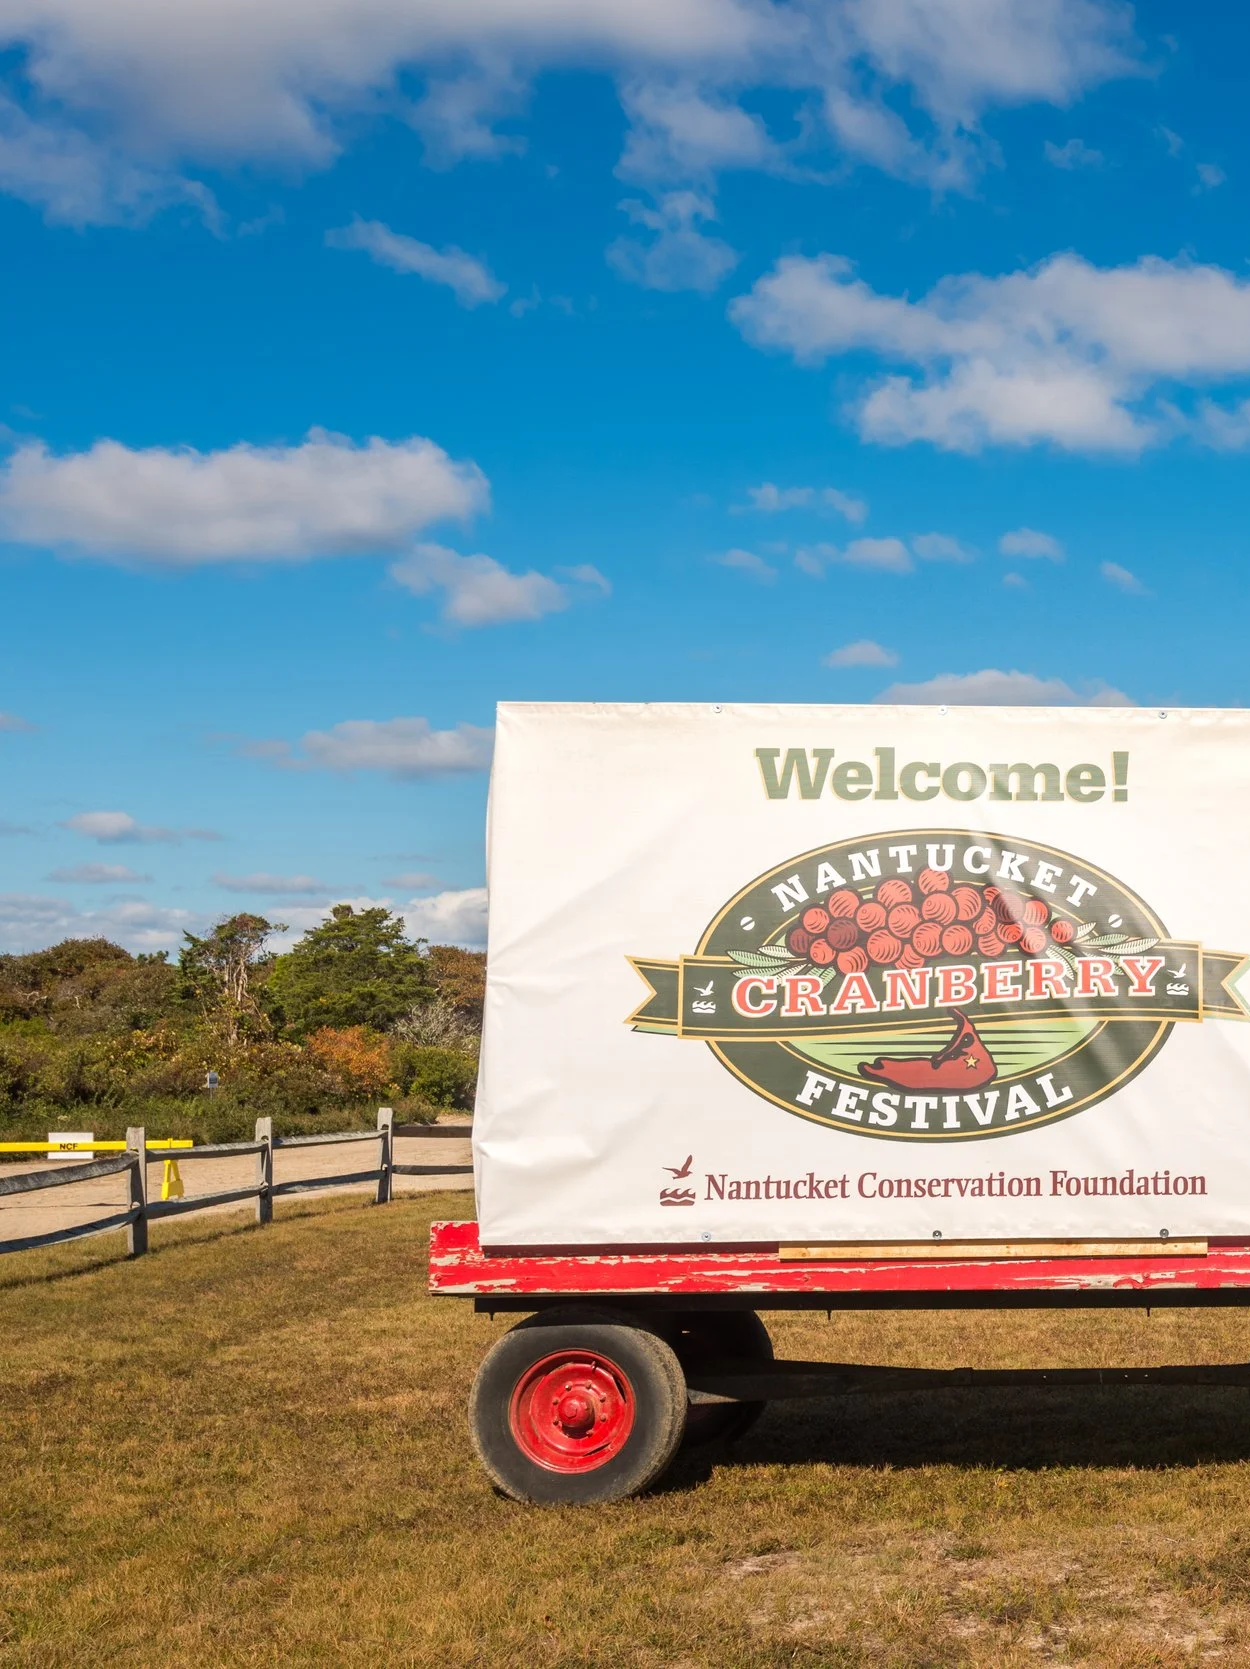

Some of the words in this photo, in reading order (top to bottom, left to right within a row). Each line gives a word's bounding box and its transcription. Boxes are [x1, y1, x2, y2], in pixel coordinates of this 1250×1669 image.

[755, 747, 1130, 803] Welcome!
[771, 843, 1097, 912] NANTUCKET
[732, 956, 1165, 1018] CRANBERRY
[795, 1071, 1074, 1130] FESTIVAL
[59, 1143, 79, 1151] NCF
[704, 1172, 850, 1201] Nantucket
[857, 1171, 1042, 1199] Conservation
[1049, 1169, 1208, 1197] Foundation
